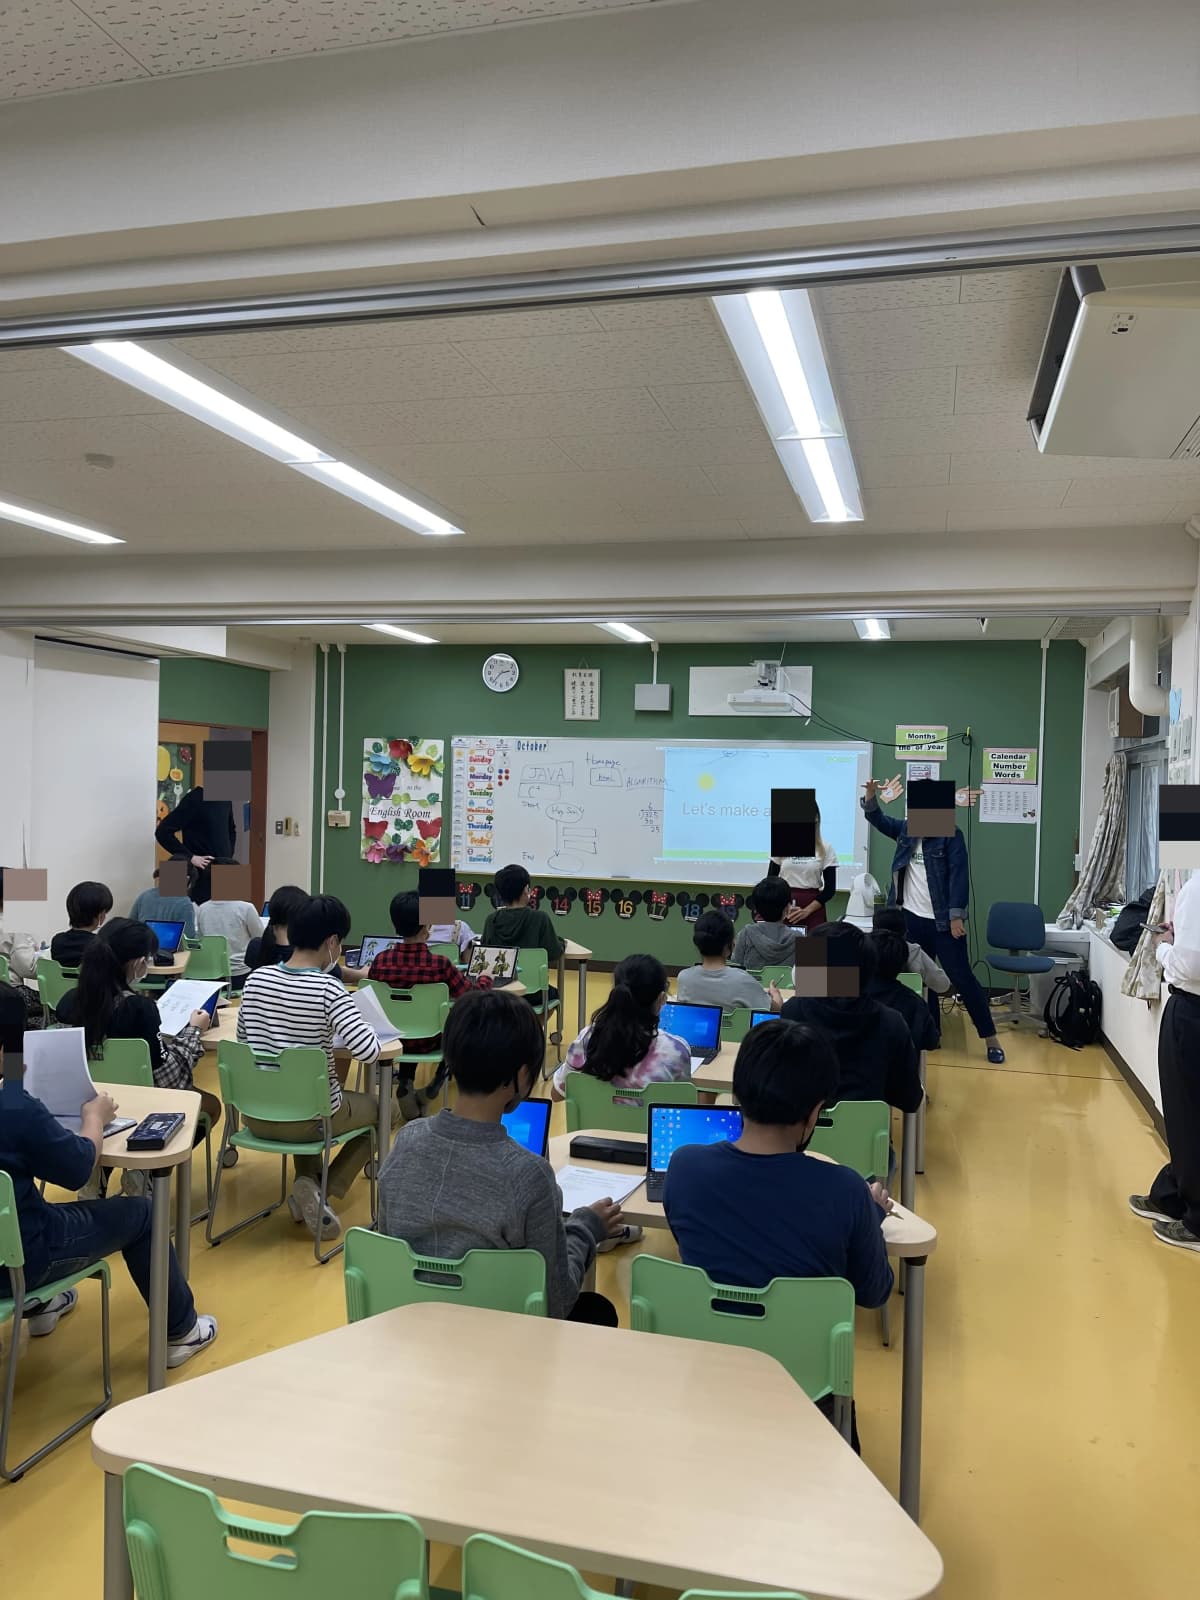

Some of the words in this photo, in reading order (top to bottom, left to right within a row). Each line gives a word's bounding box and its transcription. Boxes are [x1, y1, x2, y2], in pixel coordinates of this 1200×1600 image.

[517, 740, 548, 751] October
[927, 743, 945, 751] year
[469, 754, 493, 765] Sunday
[992, 762, 1026, 770] Number
[469, 772, 493, 782] Monday
[528, 767, 566, 780] JAVA
[469, 788, 494, 799] Tuesday
[369, 806, 401, 819] English
[403, 806, 432, 820] Room
[466, 806, 494, 815] Wednesday
[682, 800, 716, 816] Let's
[719, 803, 759, 817] make
[466, 822, 493, 831] Thursday
[470, 836, 490, 846] Friday
[460, 893, 471, 907] 11
[553, 898, 570, 911] 14
[586, 900, 602, 915] 15
[618, 899, 633, 915] 16
[651, 902, 667, 916] 17
[684, 903, 700, 918] 18
